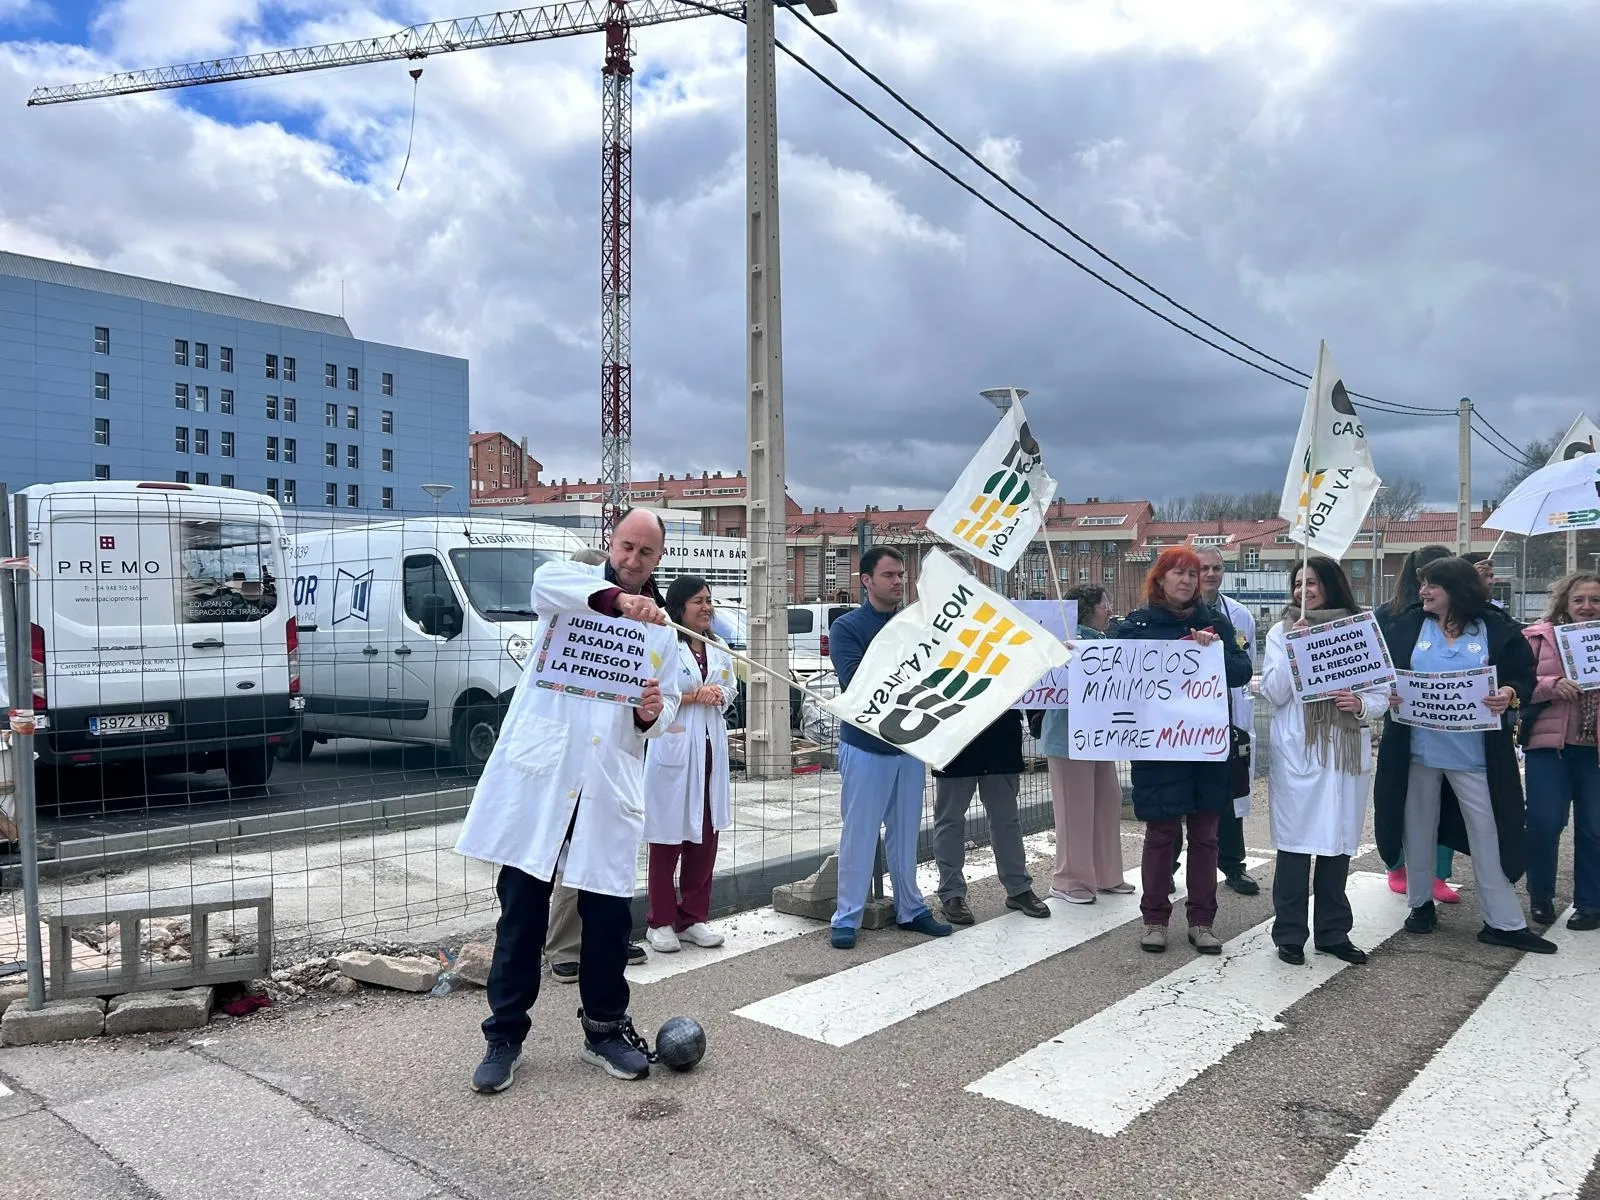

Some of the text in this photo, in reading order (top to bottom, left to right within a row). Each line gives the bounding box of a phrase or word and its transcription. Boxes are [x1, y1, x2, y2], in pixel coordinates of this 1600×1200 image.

[468, 535, 514, 545] ELISOR
[693, 548, 725, 558] SANTA
[58, 560, 160, 574] PREMO
[291, 575, 317, 606] OR
[239, 608, 269, 616] TRABAJO
[568, 617, 645, 642] JUBILACIÓN
[568, 632, 644, 657] BASADA EN
[1306, 629, 1364, 651] JUBILACIÓN
[562, 647, 642, 671] EL RIESGO Y
[1081, 645, 1201, 676] SERVICIOS
[1311, 641, 1367, 661] BASADA EN
[1312, 652, 1370, 673] EL RIESGO Y
[1583, 666, 1598, 674] LA
[551, 660, 648, 688] LA PENOSIDAD
[1308, 676, 1323, 686] LA
[1324, 661, 1381, 682] PENOSIDAD
[1082, 675, 1223, 703] MÍNIMOS 100%
[1409, 680, 1474, 690] MEJORAS
[1016, 687, 1068, 705] OTRO
[1410, 700, 1477, 711] JORNADA
[1422, 692, 1440, 700] EN
[100, 714, 166, 730] 5972 KKB
[1412, 710, 1477, 721] LABORAL
[1074, 729, 1154, 751] SIEMPRE
